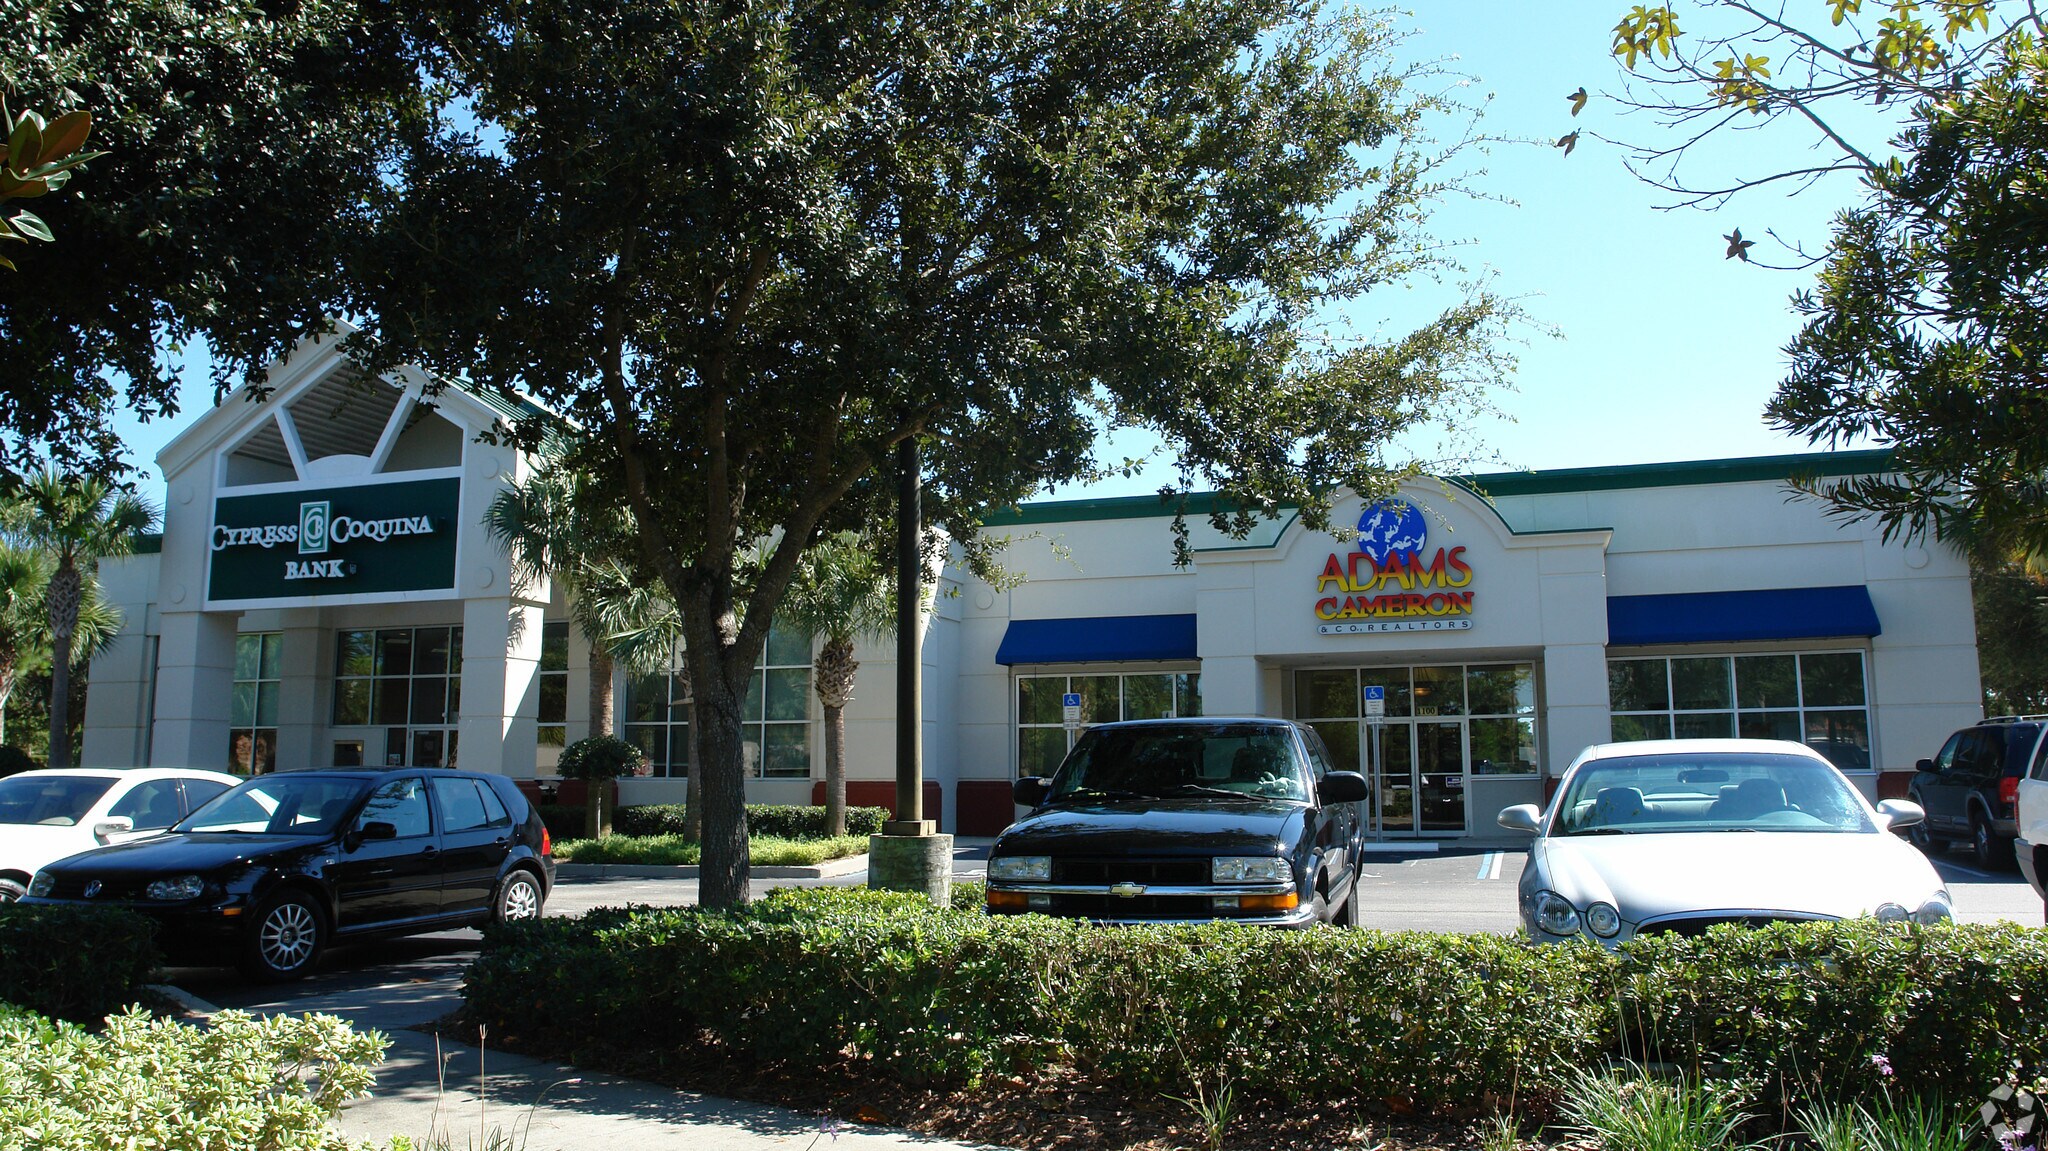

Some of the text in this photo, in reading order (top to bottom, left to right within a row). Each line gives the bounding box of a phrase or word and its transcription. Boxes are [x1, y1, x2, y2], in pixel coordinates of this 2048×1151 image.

[284, 559, 344, 580] BANK
[1317, 546, 1473, 593] ADAMS
[1315, 592, 1475, 620] CAMERON
[1367, 621, 1469, 631] REALTORS
[1417, 707, 1435, 715] 1100
